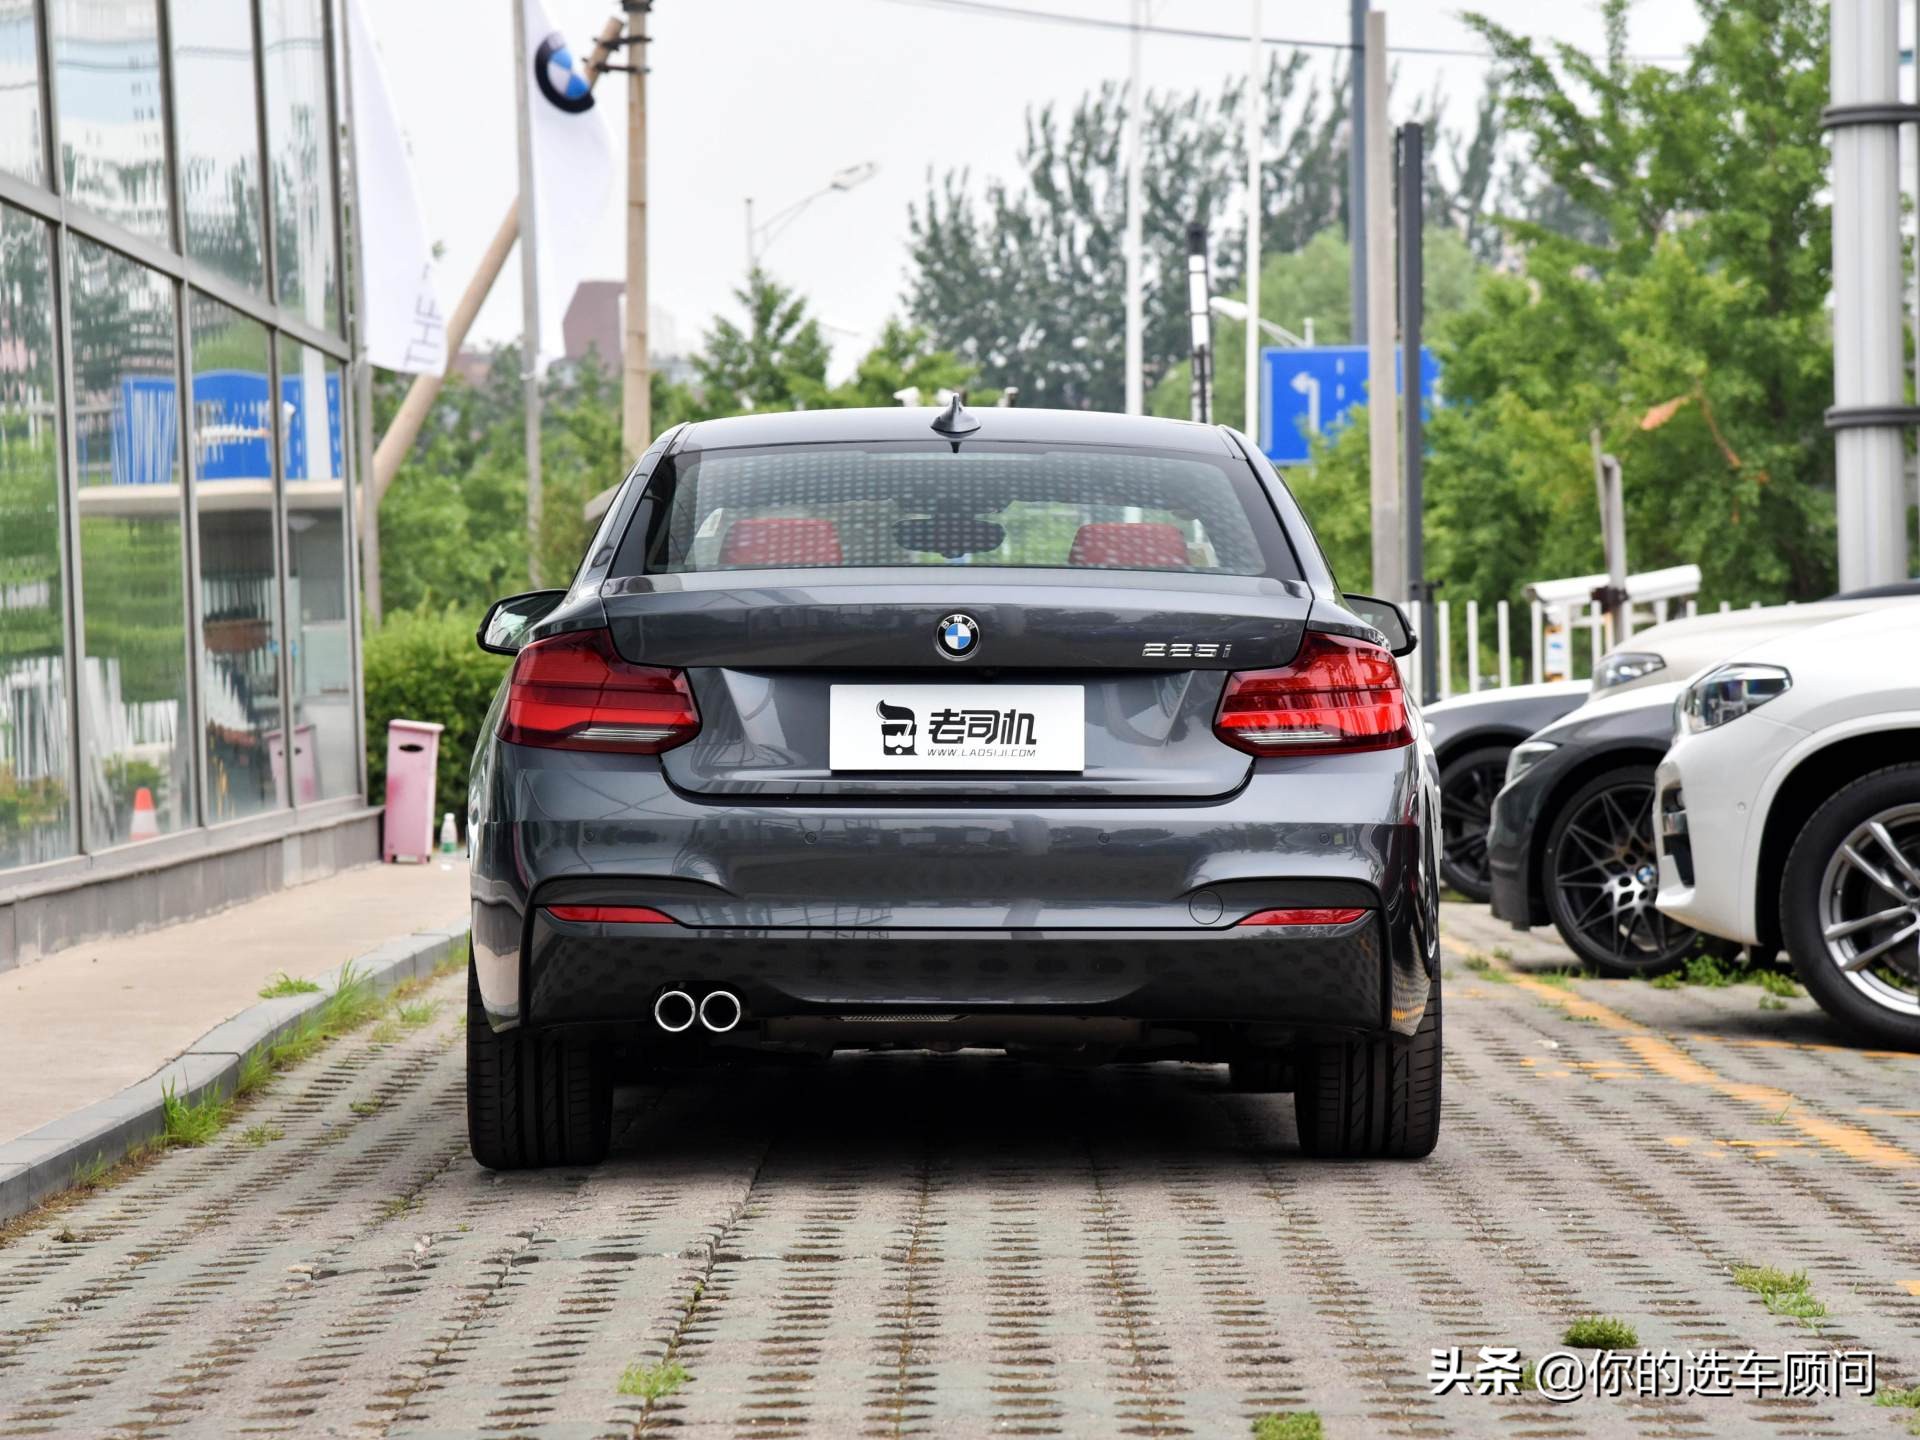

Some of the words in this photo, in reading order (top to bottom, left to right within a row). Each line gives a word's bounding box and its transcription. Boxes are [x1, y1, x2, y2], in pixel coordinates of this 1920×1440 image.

[1142, 643, 1232, 658] 225i
[928, 708, 1037, 745] 老司机
[927, 748, 1036, 757] WWW.LAOSIJI.COM
